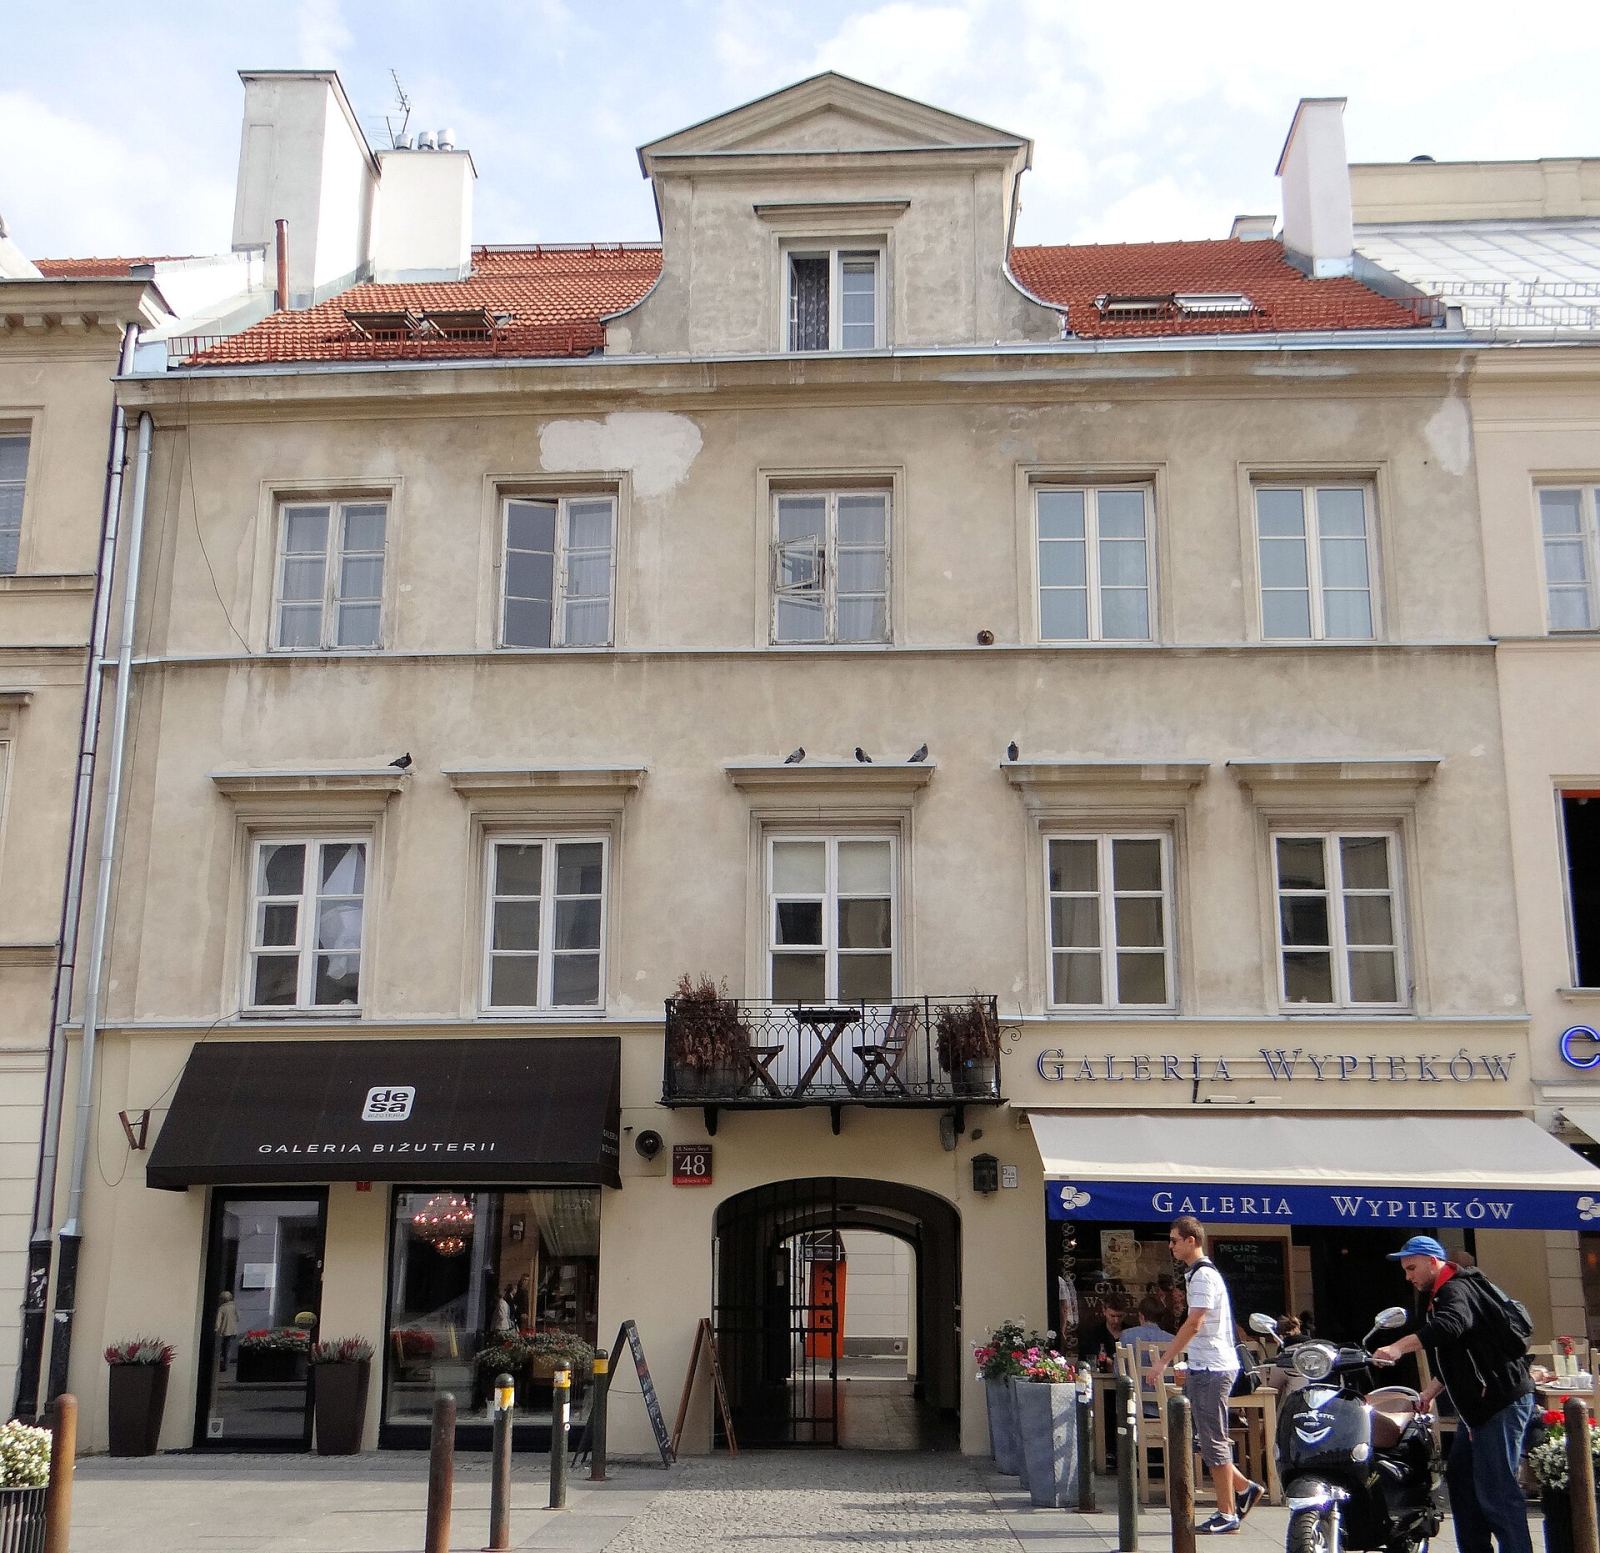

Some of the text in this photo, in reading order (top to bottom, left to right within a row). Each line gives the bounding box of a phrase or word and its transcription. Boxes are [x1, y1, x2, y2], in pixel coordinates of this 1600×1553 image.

[1036, 1048, 1517, 1083] GALERIA WYPIEKÓW
[258, 1142, 496, 1153] GALERIA BIŻUTERII
[679, 1154, 706, 1176] 48
[1152, 1191, 1515, 1220] GALERIA WYPIEKÓW
